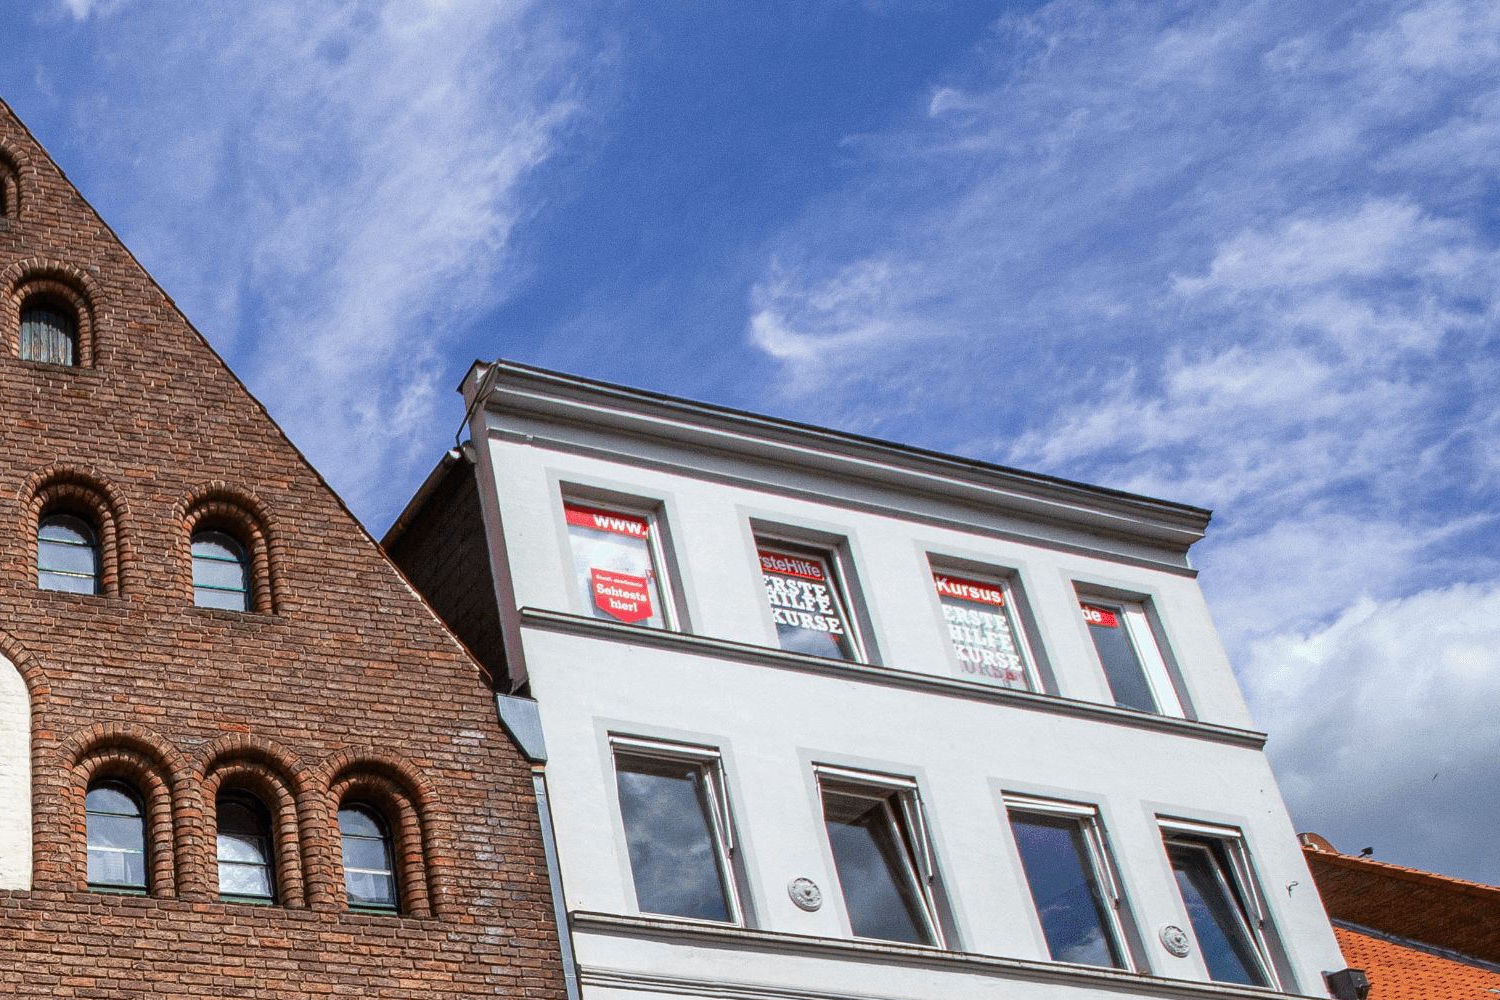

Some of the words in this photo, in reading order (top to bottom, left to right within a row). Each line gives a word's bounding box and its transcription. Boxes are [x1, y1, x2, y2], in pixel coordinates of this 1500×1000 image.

[593, 514, 647, 535] www.
[759, 556, 821, 577] steHilfe
[596, 583, 647, 602] Sehtests
[762, 574, 830, 600] ERSTE
[935, 577, 1001, 603] Kursus
[609, 597, 638, 612] hier!
[768, 591, 834, 615] HILFE
[772, 607, 844, 634] KURSE
[941, 603, 1009, 632] ERSTE
[947, 623, 1014, 652] HILFE
[954, 643, 1023, 672] KURSE
